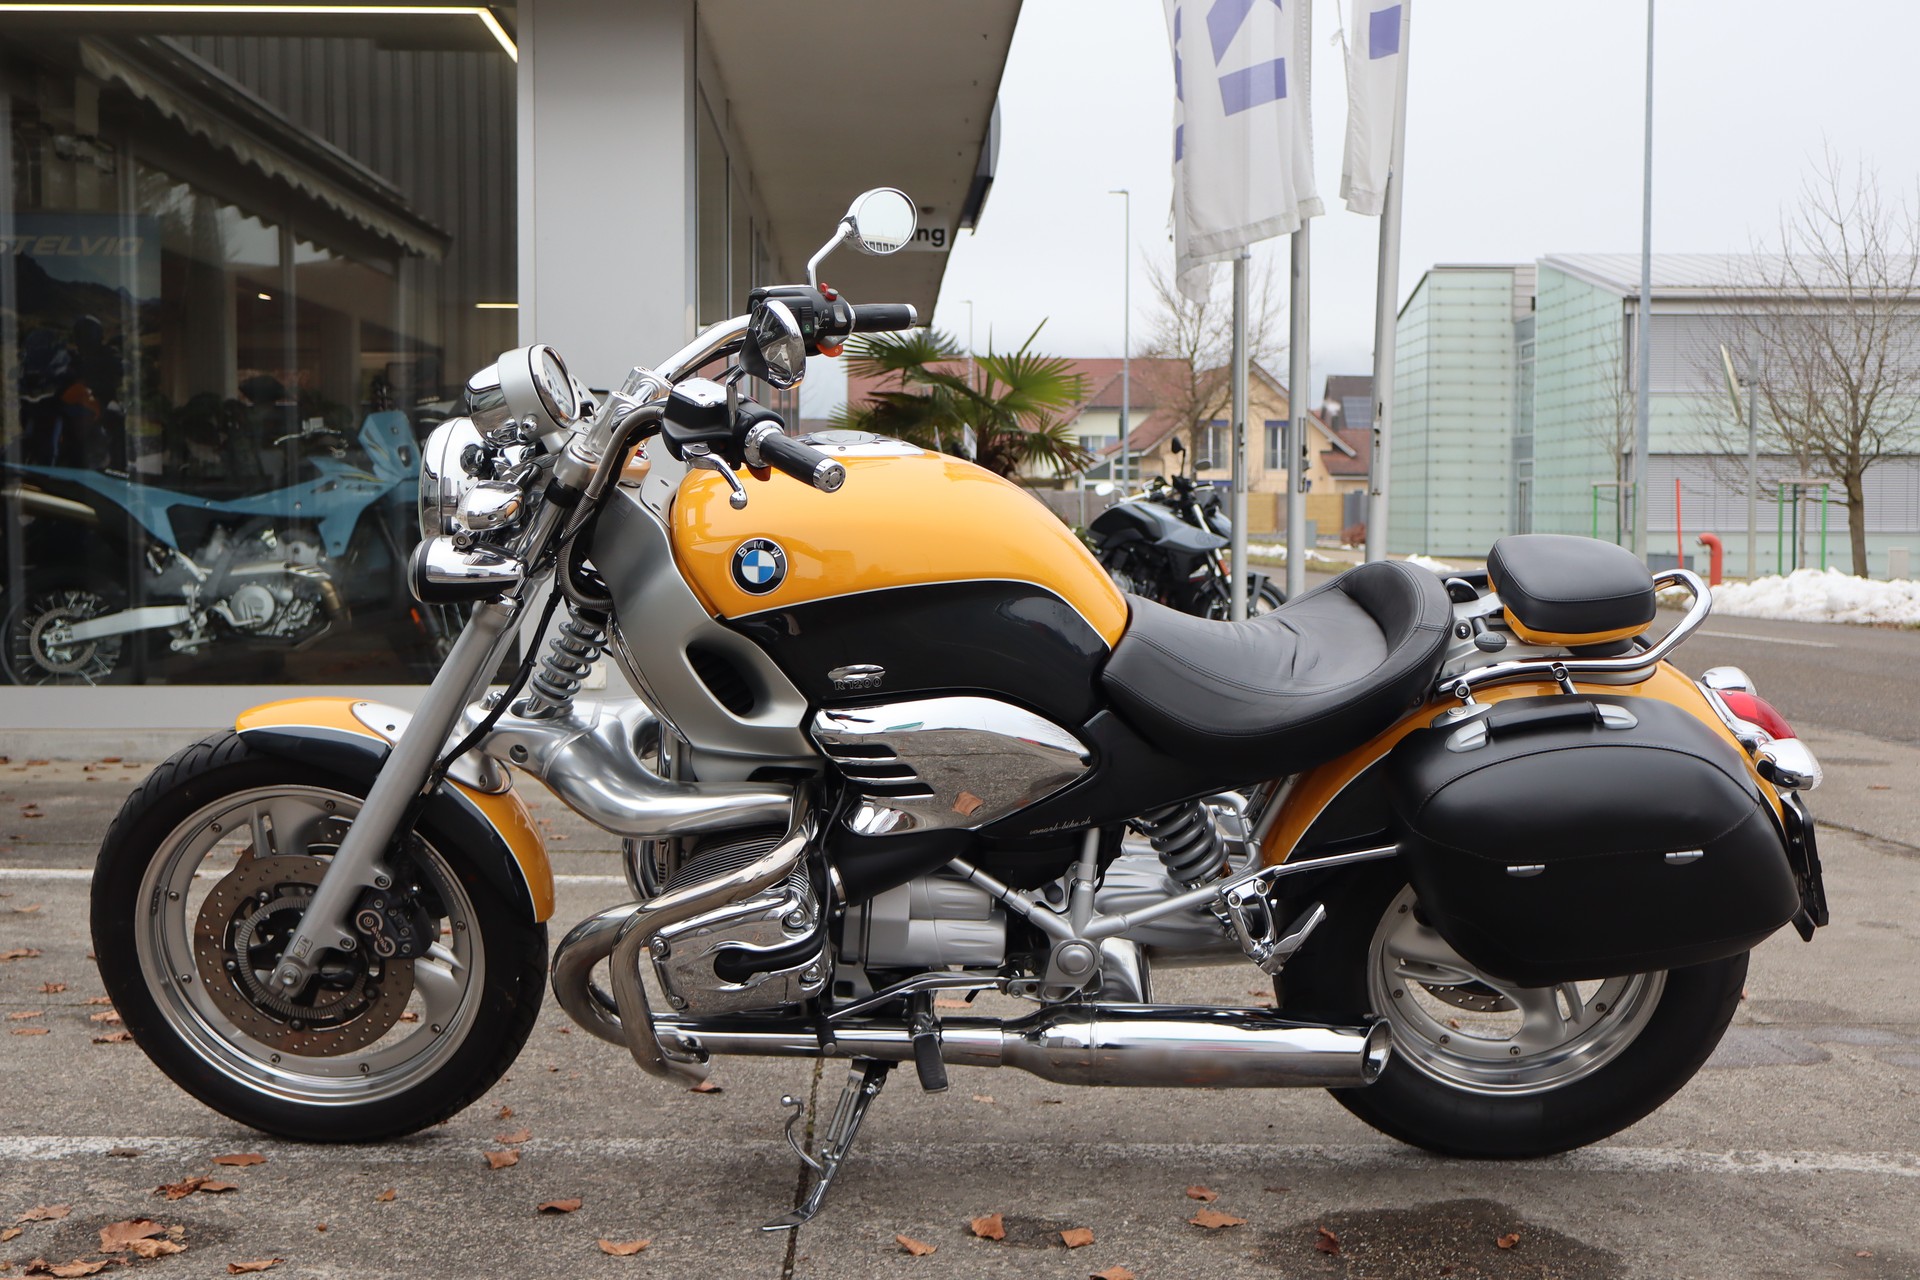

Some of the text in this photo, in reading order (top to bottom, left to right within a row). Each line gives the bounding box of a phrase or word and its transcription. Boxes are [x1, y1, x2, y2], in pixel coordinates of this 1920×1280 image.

[911, 228, 945, 247] ng
[737, 540, 782, 558] BMW
[834, 676, 882, 691] R 1200
